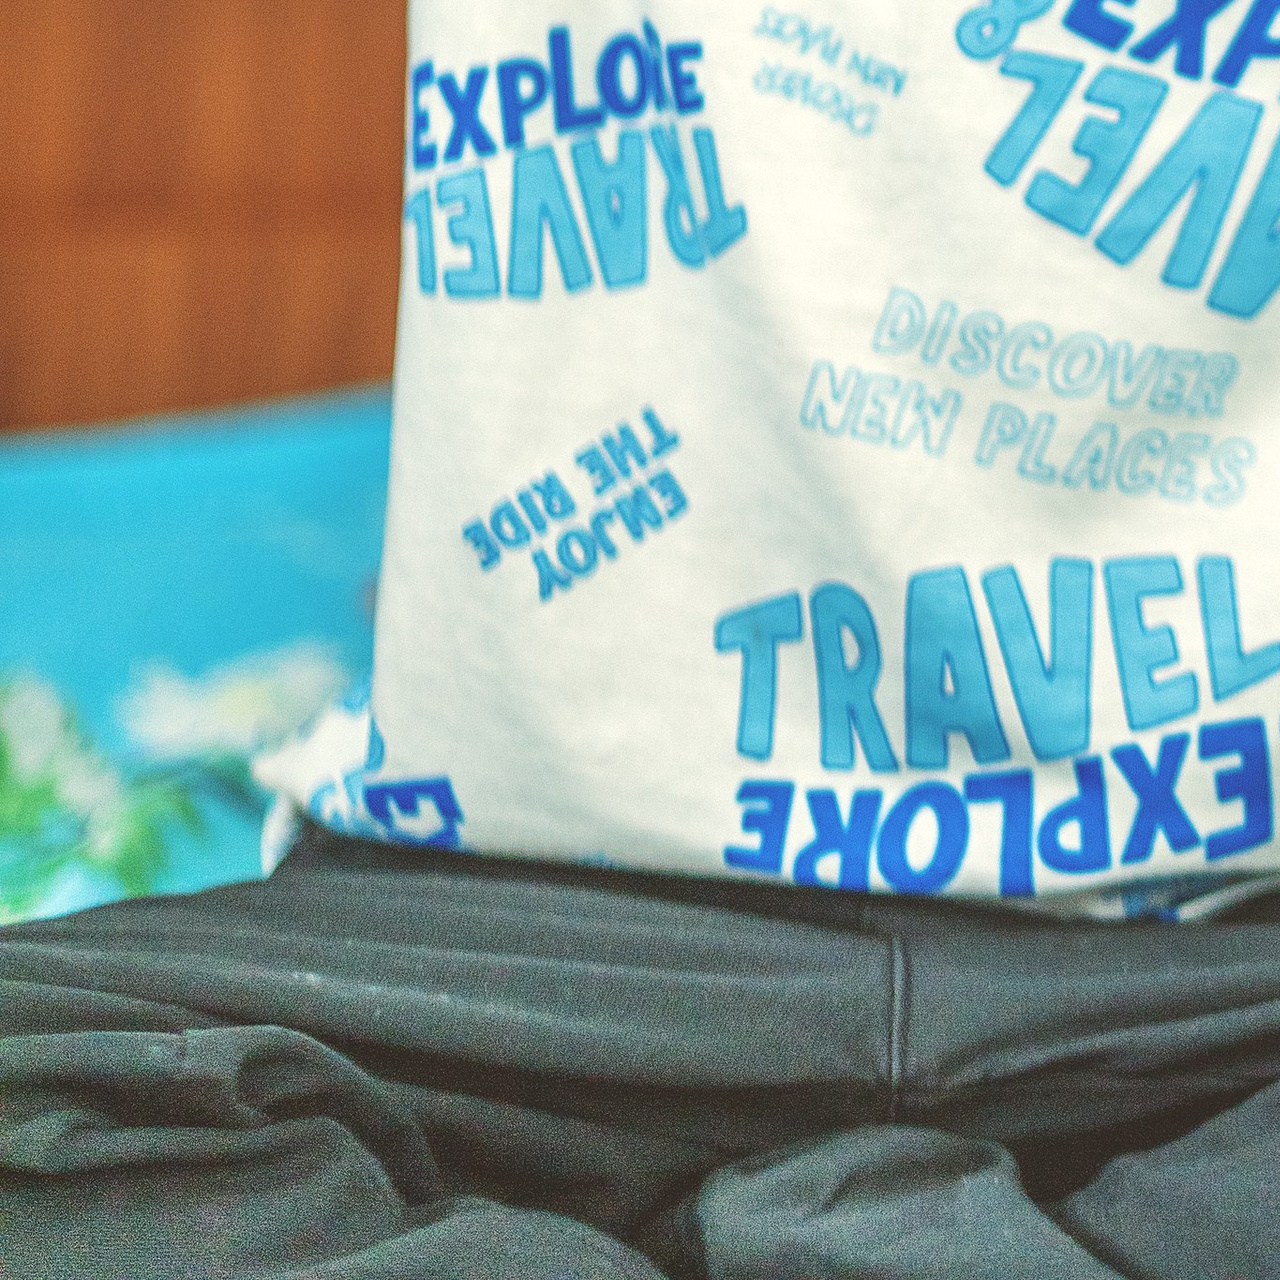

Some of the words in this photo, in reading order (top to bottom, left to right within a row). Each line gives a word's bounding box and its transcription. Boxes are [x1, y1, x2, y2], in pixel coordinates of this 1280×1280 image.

[872, 285, 1242, 420] DISCOVER
[573, 402, 683, 497] THE
[800, 359, 963, 461] NEW
[973, 400, 1259, 509] PLACES
[460, 468, 579, 573] RIDE
[532, 465, 691, 604] ENJOY
[723, 715, 1276, 899] EXPLORE
